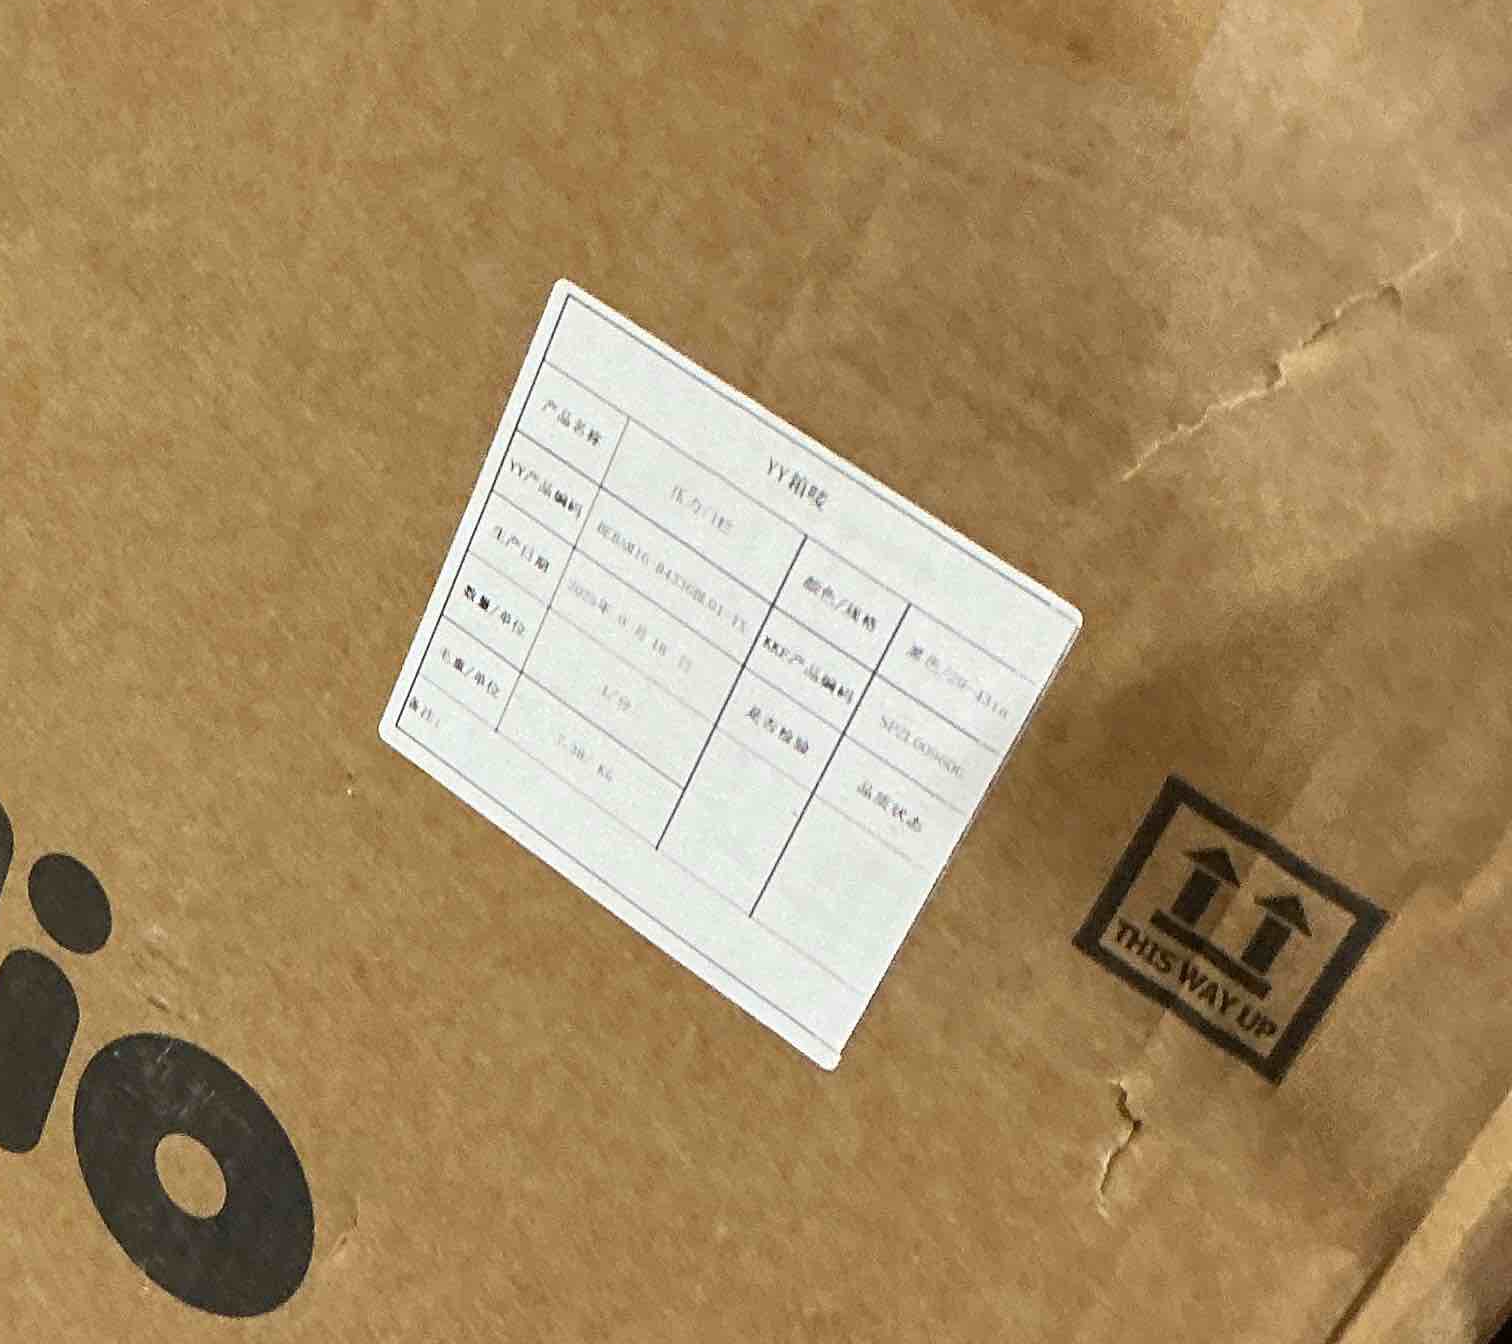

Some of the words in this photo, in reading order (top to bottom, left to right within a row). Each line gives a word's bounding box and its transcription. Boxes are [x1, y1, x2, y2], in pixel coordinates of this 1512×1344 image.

[1116, 917, 1172, 974] THIS
[1178, 956, 1238, 1013] WAY
[1237, 1006, 1277, 1039] UP
